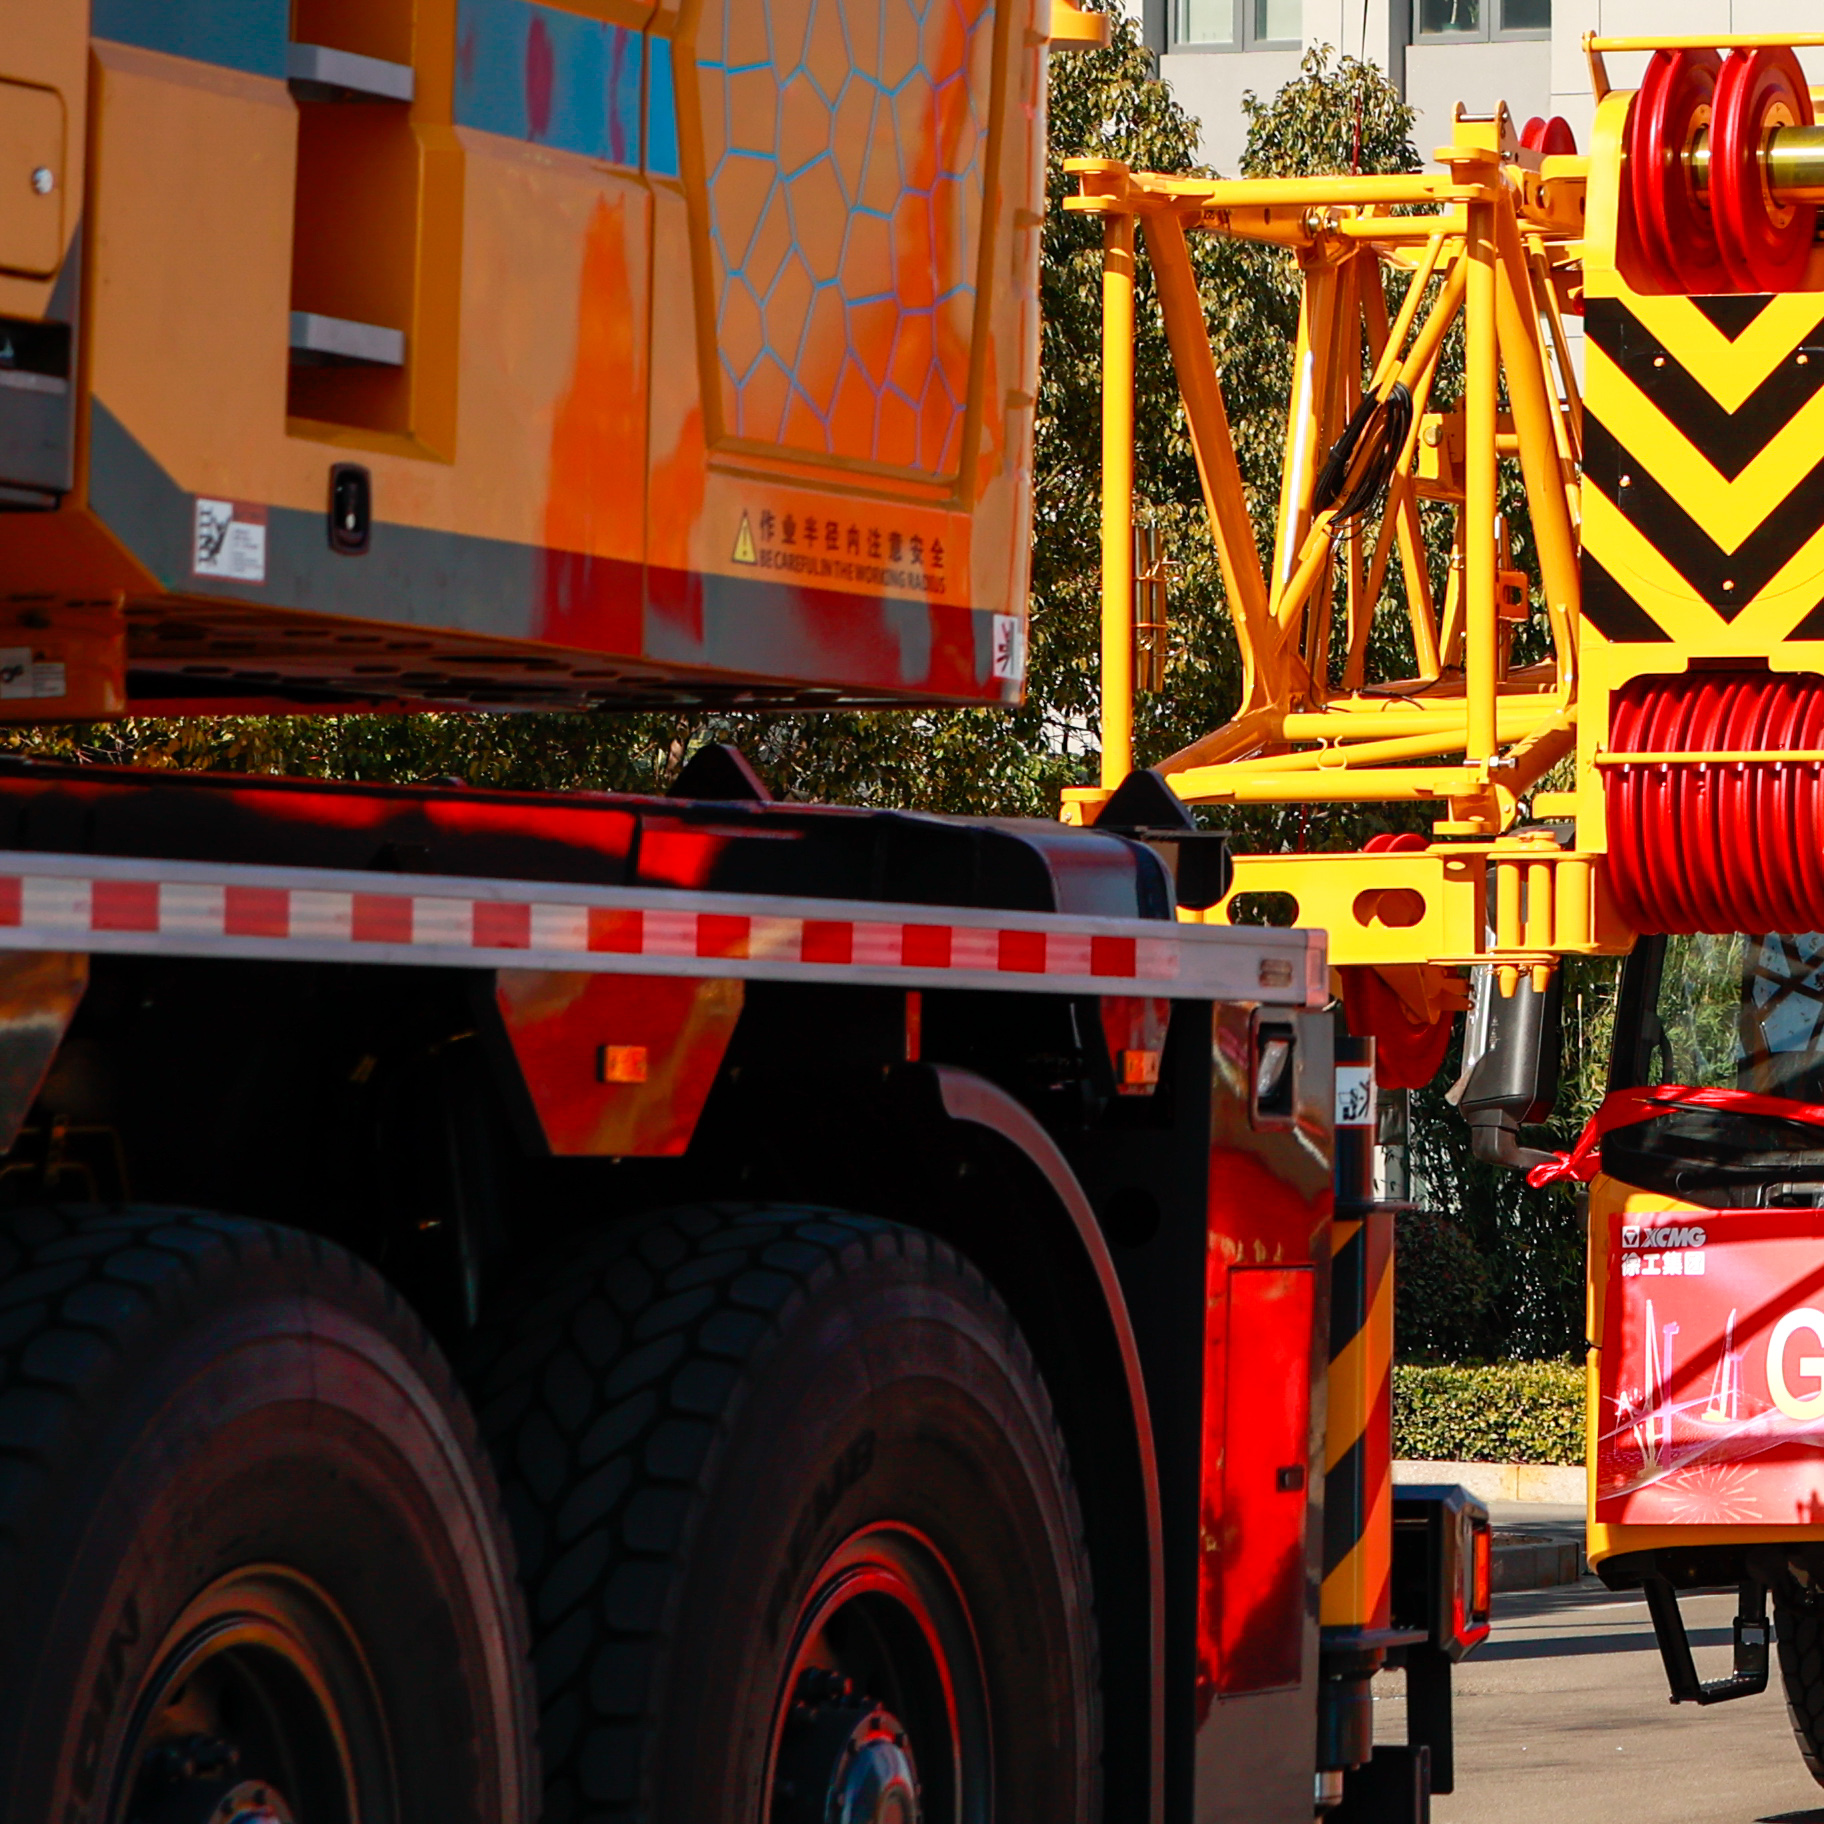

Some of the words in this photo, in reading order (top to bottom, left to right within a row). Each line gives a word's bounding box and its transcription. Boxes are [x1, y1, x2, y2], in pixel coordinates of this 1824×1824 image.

[758, 509, 945, 569] 作业半径内注意安全
[1640, 1226, 1707, 1248] XCMG
[1621, 1250, 1706, 1277] 徐工集团
